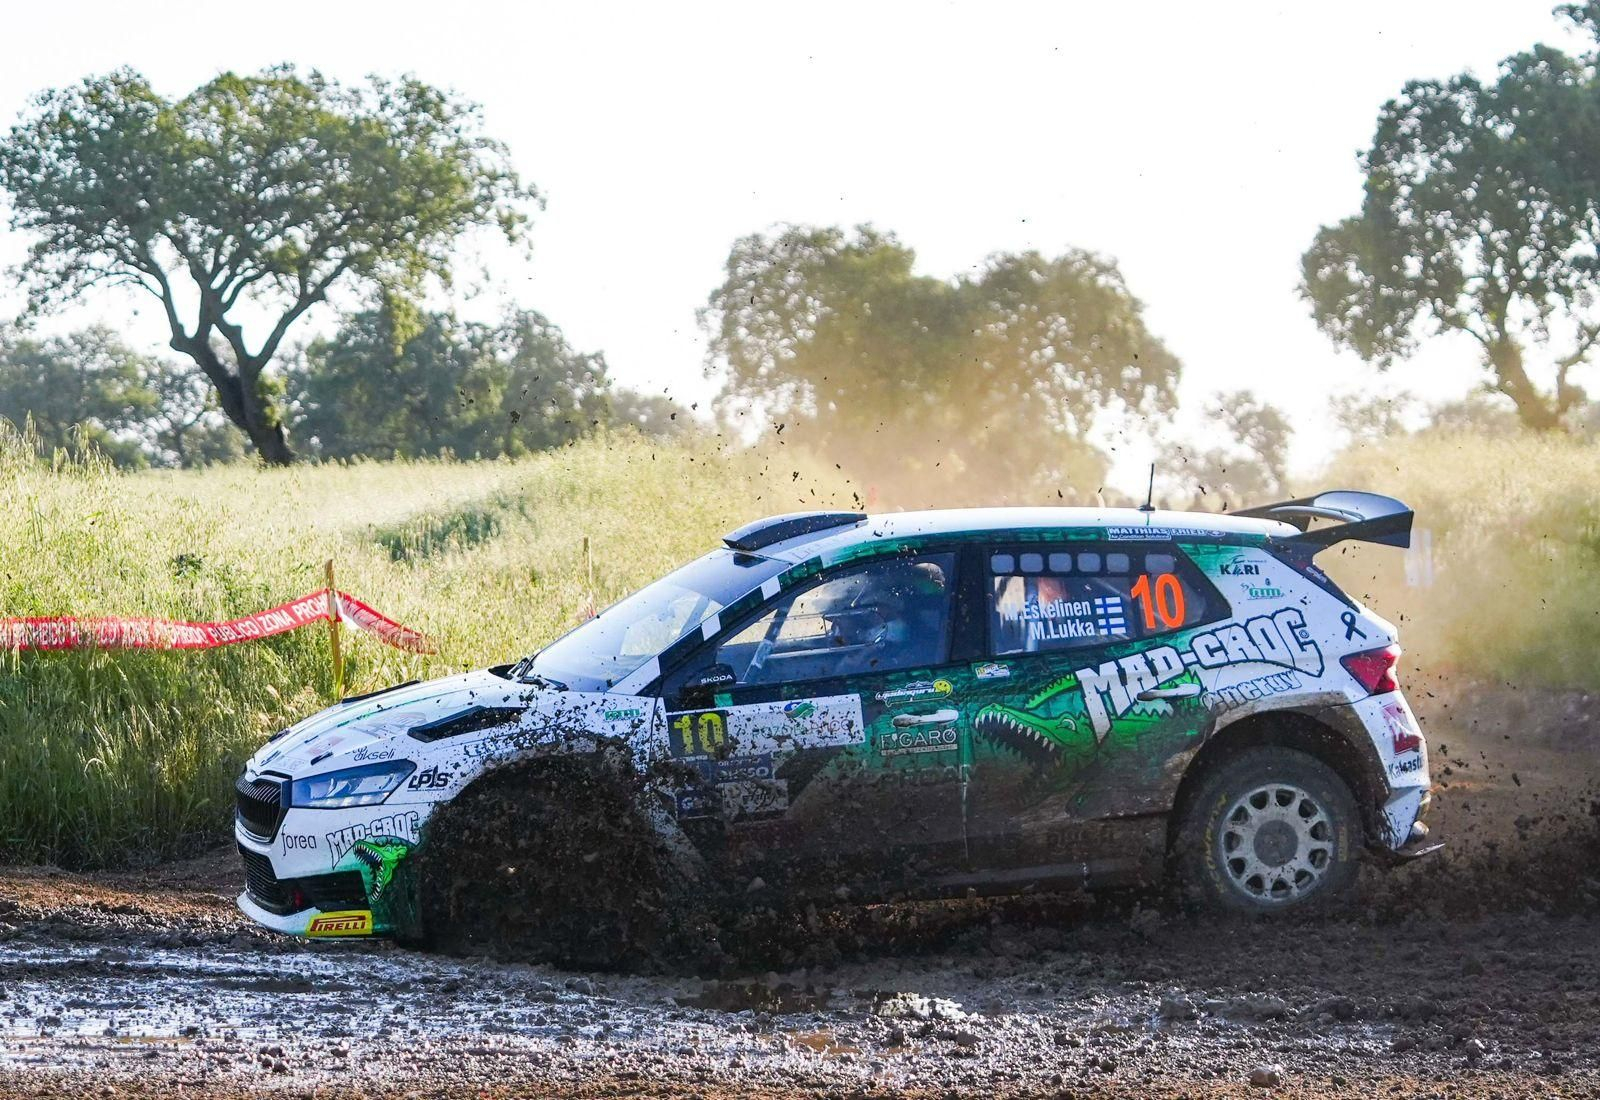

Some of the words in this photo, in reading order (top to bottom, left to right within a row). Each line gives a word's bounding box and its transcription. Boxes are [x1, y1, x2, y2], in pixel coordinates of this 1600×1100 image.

[1131, 573, 1185, 629] 10
[257, 609, 296, 632] ZONA
[1029, 618, 1095, 641] M.Lukka
[674, 712, 724, 753] 10
[880, 727, 957, 750] FIGARO
[281, 824, 317, 857] forea
[309, 915, 366, 932] PIRELLI
